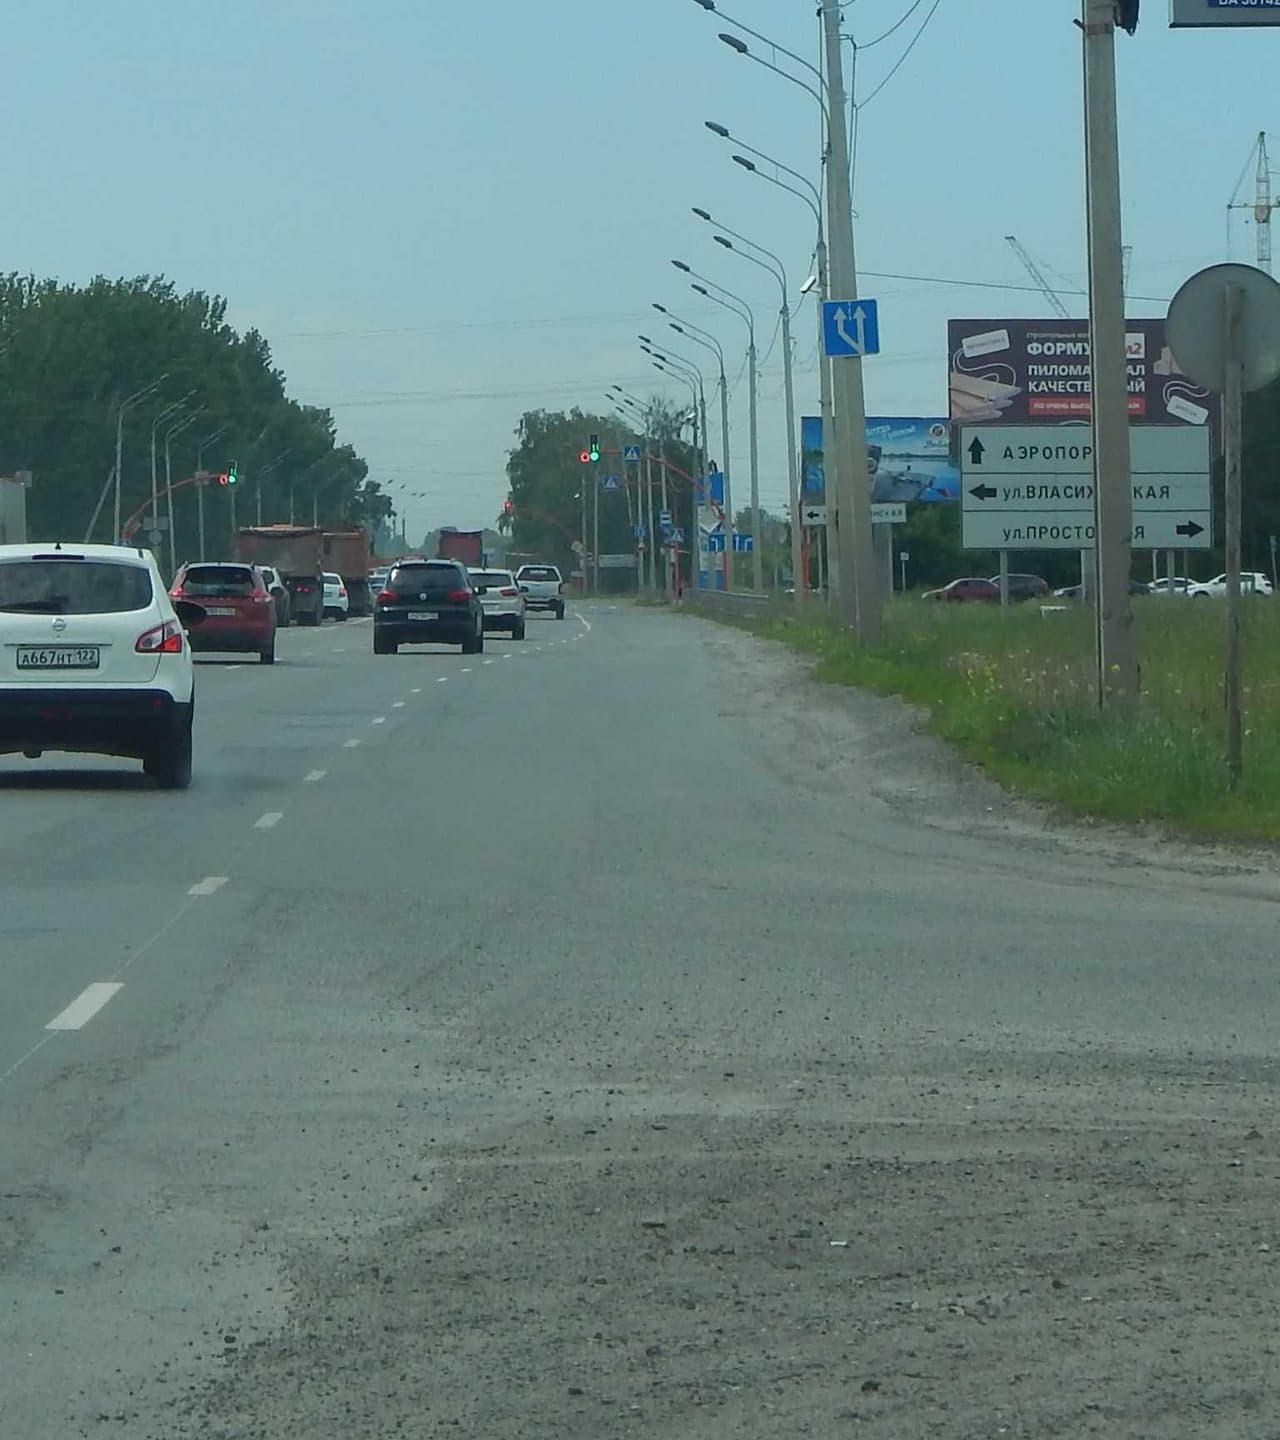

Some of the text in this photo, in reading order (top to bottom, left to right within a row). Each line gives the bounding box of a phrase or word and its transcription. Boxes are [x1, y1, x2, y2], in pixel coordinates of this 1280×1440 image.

[1026, 341, 1091, 356] ФОРМУ
[1028, 364, 1146, 376] ПИЛОМААЛ
[1002, 446, 1093, 461] АЭРОПОР
[22, 650, 96, 665] А667НТ 122
